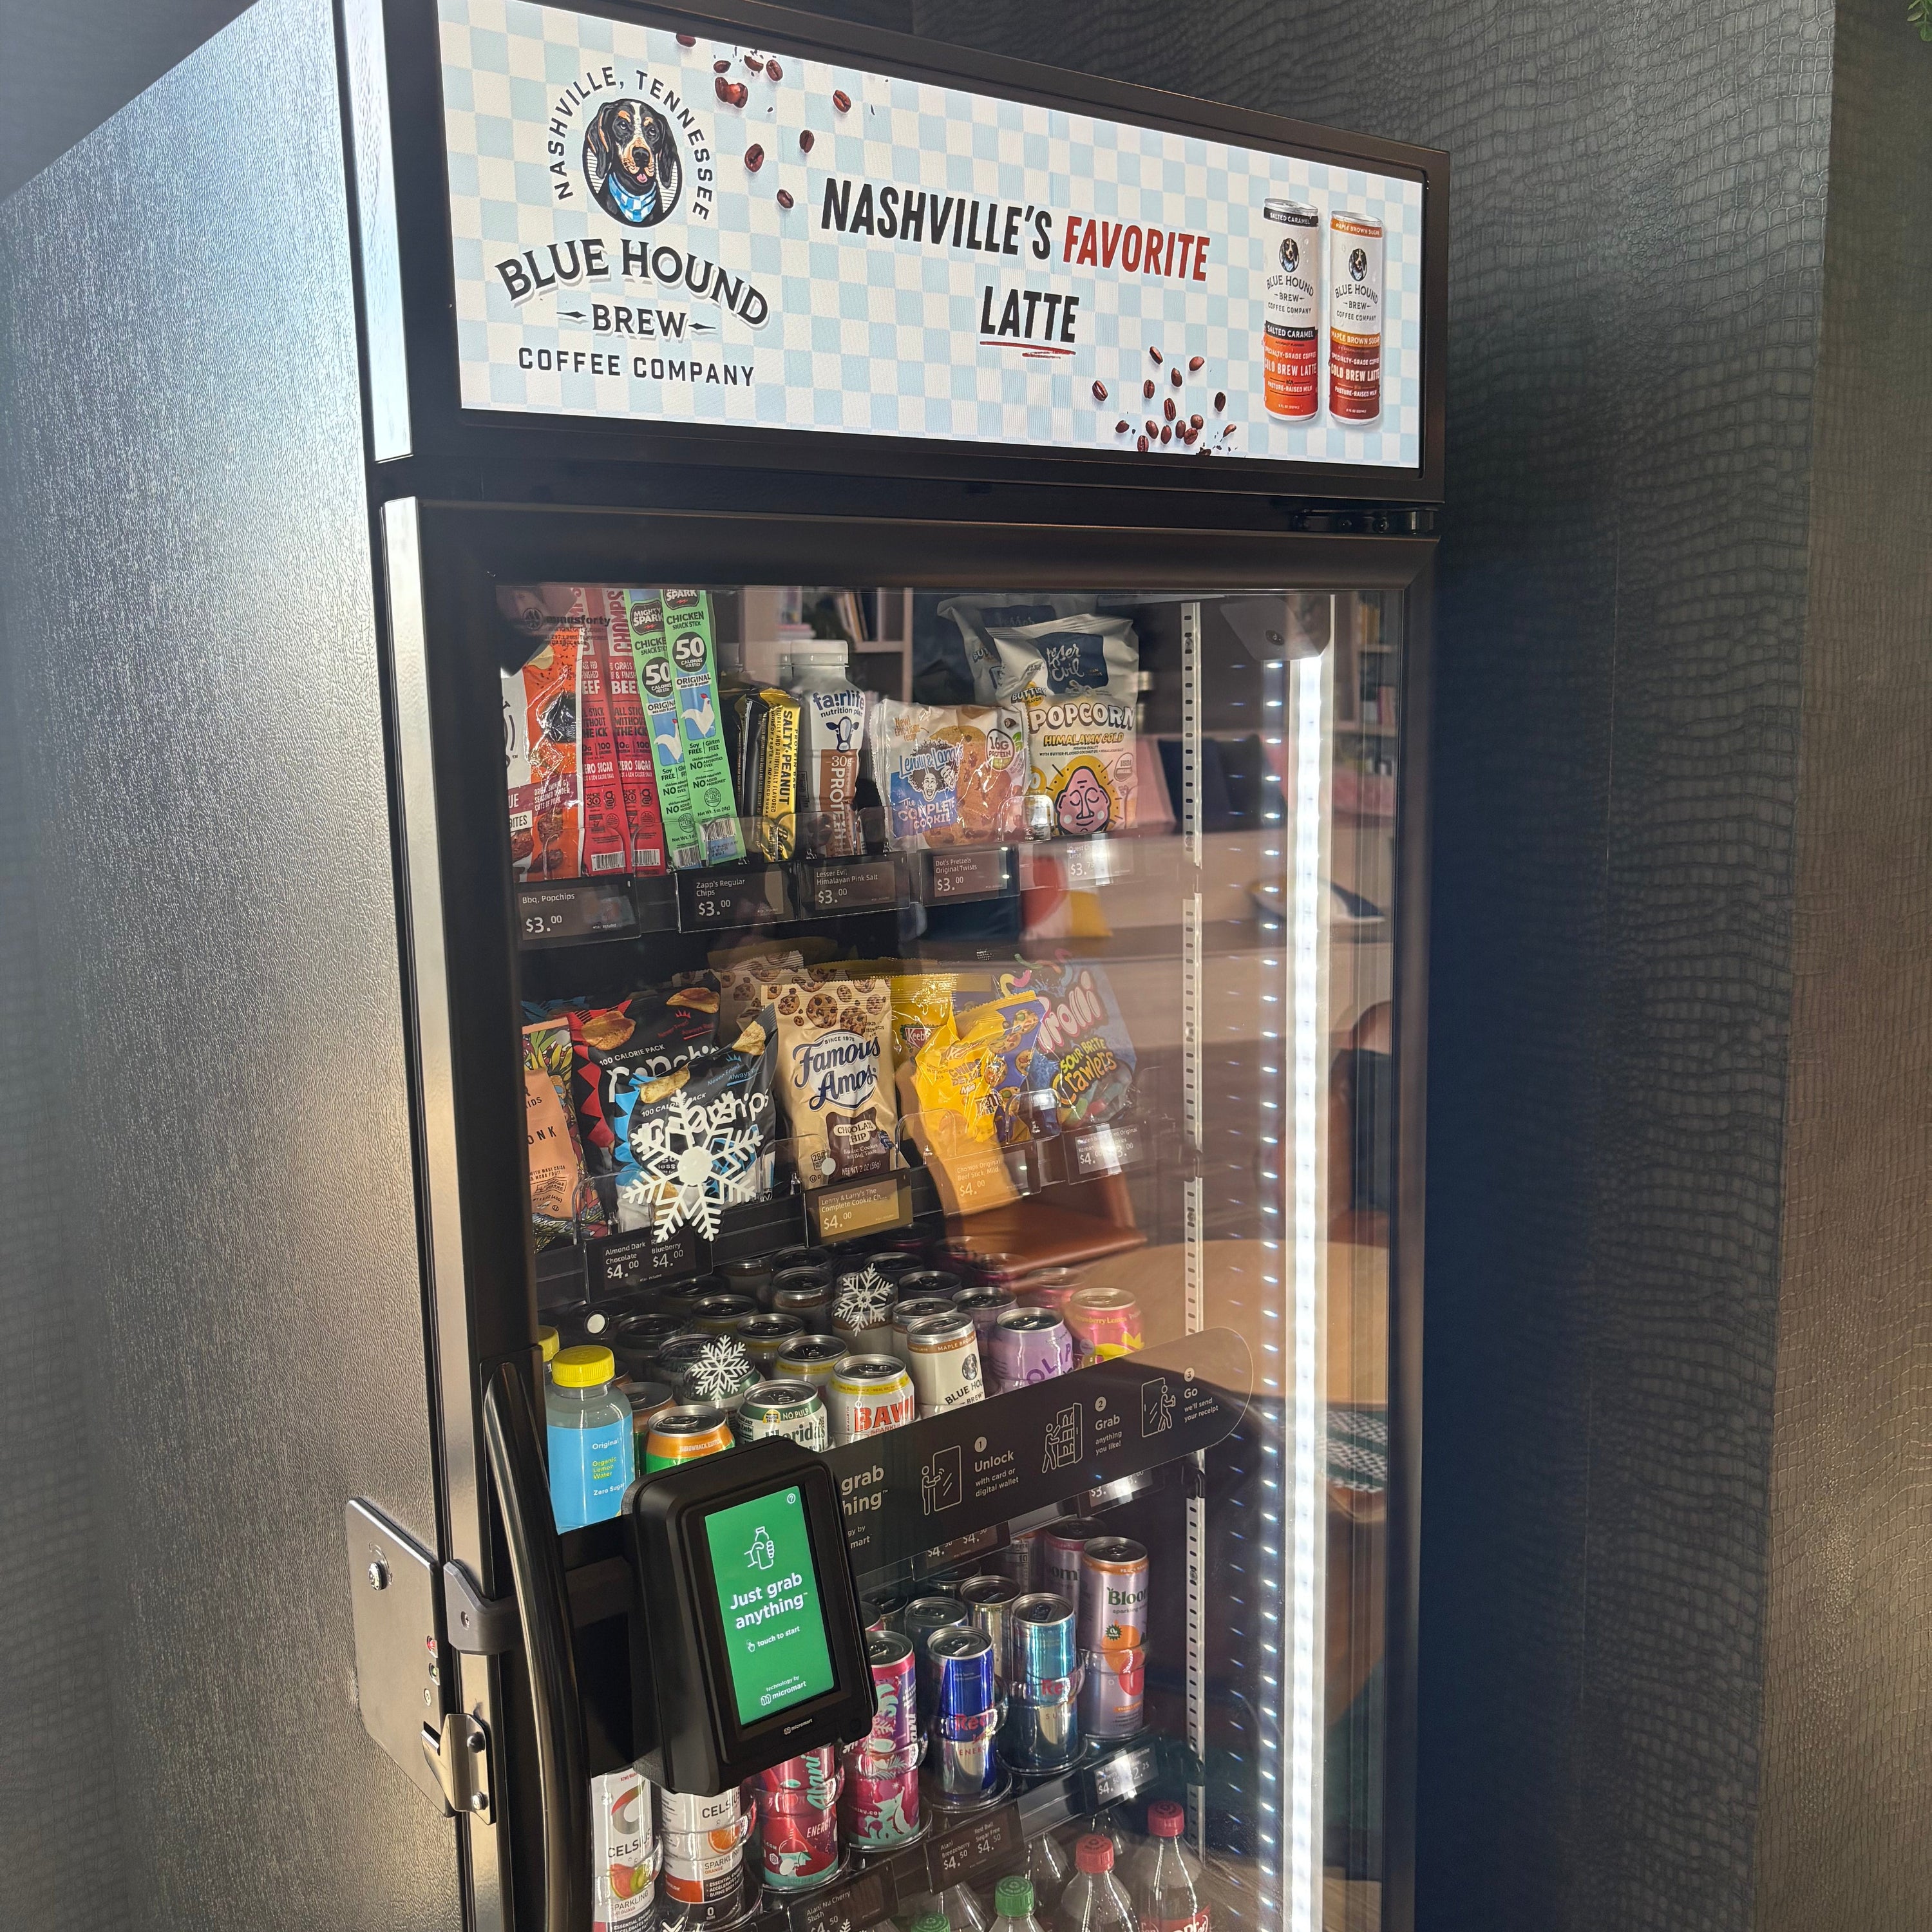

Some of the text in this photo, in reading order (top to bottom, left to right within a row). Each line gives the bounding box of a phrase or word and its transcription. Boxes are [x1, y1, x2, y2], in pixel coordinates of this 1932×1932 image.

[547, 66, 713, 220] NASHVILLE, TENNESSEE
[1270, 213, 1287, 222] SALTED
[821, 177, 1210, 281] NASHVILLE'S FAVORITE
[495, 238, 769, 325] BLUE HOUND
[1266, 275, 1314, 297] BLUE HOUND
[1280, 292, 1299, 302] BREW
[1334, 284, 1378, 304] BLUE HOUND
[980, 286, 1079, 343] LATTE
[1267, 303, 1311, 314] COFFEE COMPANY
[1336, 310, 1355, 320] COFFEE
[591, 304, 688, 338] BREW
[1267, 325, 1314, 338] SALTED CARAMEL
[1347, 334, 1367, 345] BROWN
[518, 347, 754, 386] COFFEE COMPANY
[1277, 363, 1317, 376] BREW LATTE
[1331, 363, 1379, 381] COLD BREW LATTE
[666, 589, 697, 601] SPARK
[634, 607, 661, 616] MIGHTY
[666, 611, 704, 625] CHICKEN
[634, 637, 666, 650] CHICKE
[676, 638, 705, 659] 50
[646, 662, 671, 685] 50
[677, 674, 711, 685] ORIGINAL
[821, 708, 853, 718] nutrition
[1028, 703, 1135, 734] POPCORN
[989, 737, 1009, 750] 16G
[1044, 732, 1124, 746] HIMALAYAN GOLD
[635, 761, 652, 771] SUGAR
[690, 762, 703, 770] NO
[693, 780, 706, 788] NO
[663, 787, 676, 795] NO
[666, 806, 679, 814] NO
[829, 768, 846, 839] PROTEIN
[950, 857, 971, 866] Pretzels
[837, 868, 848, 876] Evil
[936, 865, 959, 875] Original
[696, 878, 745, 889] Zapp's Regular
[817, 876, 850, 886] Himalayan
[541, 892, 575, 902] Popchips
[696, 889, 715, 897] Chips
[1037, 971, 1103, 1053] Trolli
[599, 1045, 665, 1066] 100 CALORIE PACK
[1060, 1036, 1106, 1074] SOUR BRITE
[793, 1036, 880, 1088] Famous
[1052, 1052, 1117, 1106] Crawlers
[809, 1064, 878, 1110] Amos
[641, 1108, 654, 1117] 100
[979, 1159, 1000, 1168] Original
[822, 1196, 872, 1213] Complete Cookie
[605, 1242, 646, 1256] Almond Dark
[652, 1243, 681, 1255] Blueberry
[605, 1253, 637, 1265] Chocolate
[938, 1343, 958, 1352] MAPLE
[944, 1385, 970, 1405] BLUE
[1184, 1388, 1198, 1399] Go
[1184, 1397, 1213, 1412] we'll send
[795, 1408, 809, 1417] PULP
[854, 1396, 913, 1433] BAWI
[1184, 1405, 1218, 1423] your receipt
[1095, 1414, 1120, 1430] Grab
[592, 1438, 620, 1450] Original
[1095, 1431, 1122, 1445] anything
[1095, 1440, 1121, 1456] you like!
[592, 1457, 616, 1466] Organic
[974, 1450, 1014, 1472] Unlock
[592, 1464, 614, 1473] Lemon
[841, 1465, 884, 1496] grab
[975, 1477, 990, 1487] with
[992, 1471, 1007, 1481] card
[610, 1483, 625, 1492] Sugar
[976, 1477, 1019, 1497] digital wallet
[730, 1572, 802, 1610] Just grab
[735, 1593, 804, 1629] anything
[757, 1635, 776, 1647] touch
[785, 1625, 800, 1636] start
[766, 1678, 793, 1692] technology
[772, 1680, 807, 1700] micromart
[791, 1718, 813, 1731] micromart
[807, 1817, 831, 1838] ENERGY
[976, 1832, 989, 1842] Sugar
[941, 1841, 954, 1850] Alani
[709, 1877, 732, 1887] ESSENTIAL
[807, 1906, 822, 1916] Alani
[832, 1891, 851, 1903] Cherry
[808, 1911, 824, 1923] Slush
